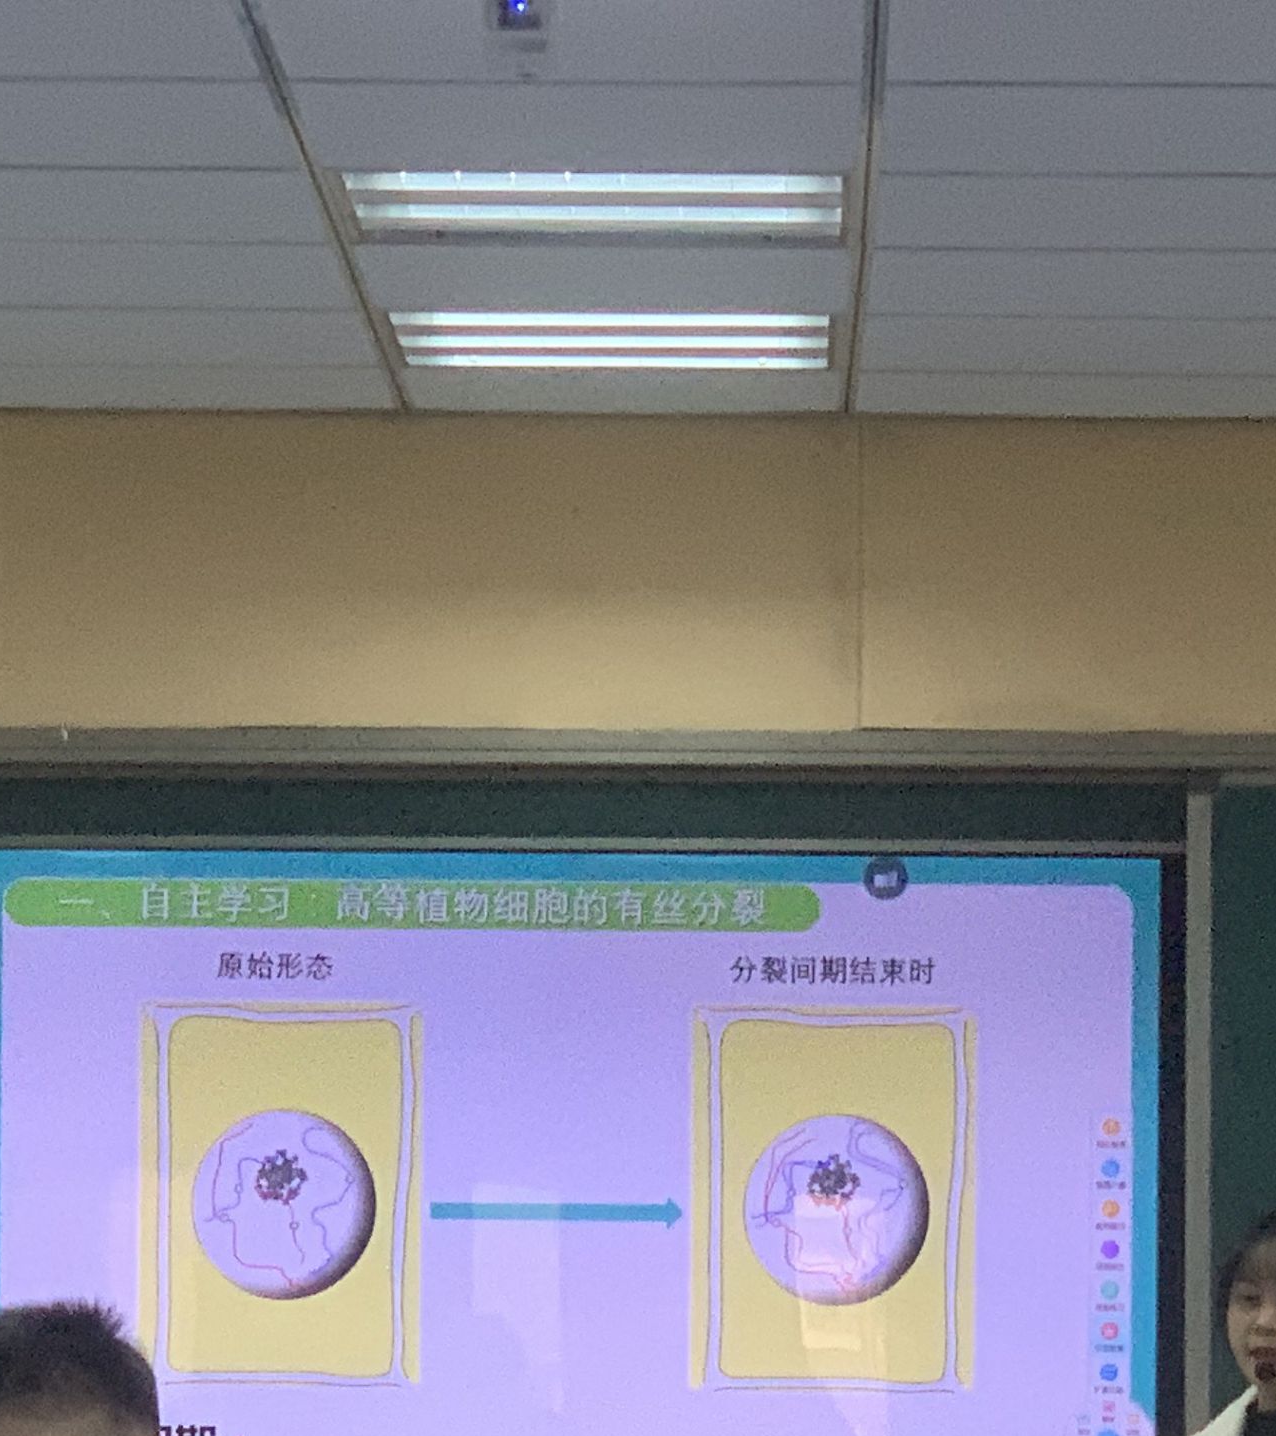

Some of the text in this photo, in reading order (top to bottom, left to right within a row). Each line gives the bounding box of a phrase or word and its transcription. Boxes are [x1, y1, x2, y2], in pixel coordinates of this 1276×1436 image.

[217, 951, 335, 981] 原始形态
[729, 956, 938, 986] 分裂间期结束时
